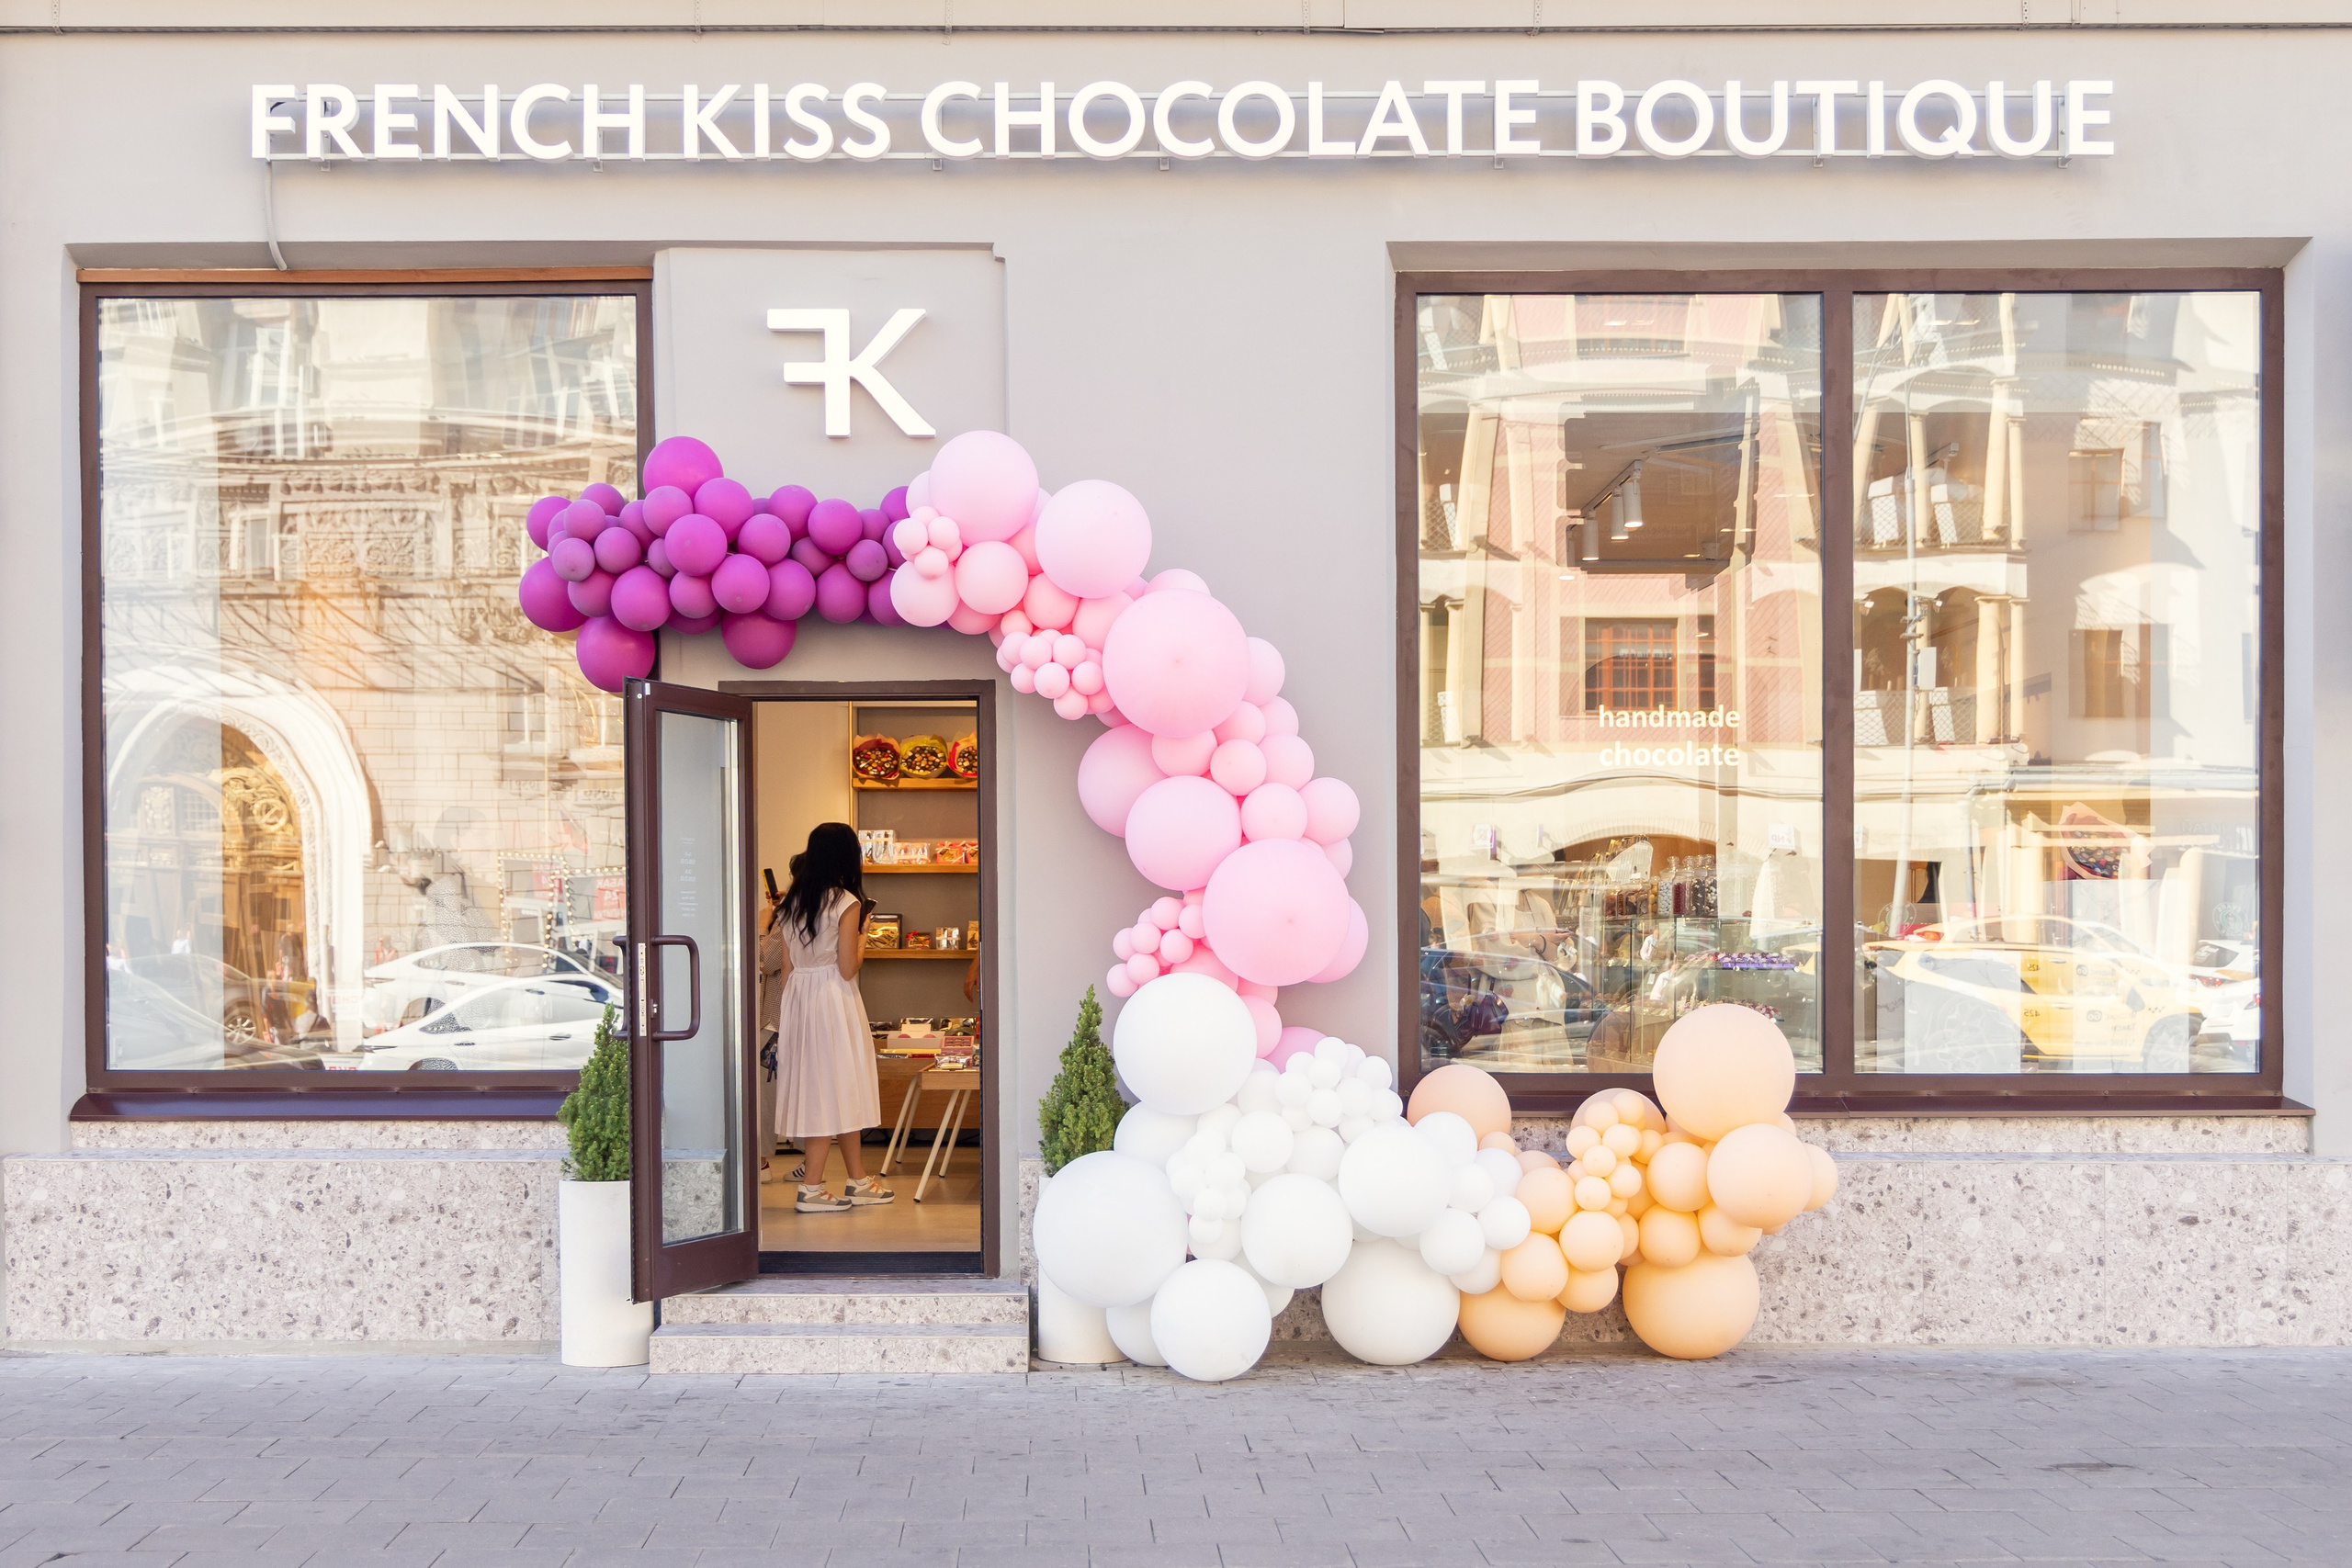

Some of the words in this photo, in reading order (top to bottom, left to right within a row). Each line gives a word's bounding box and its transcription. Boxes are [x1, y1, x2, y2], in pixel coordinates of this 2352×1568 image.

[251, 83, 645, 163] FRENCH
[683, 82, 892, 163] KISS
[921, 80, 1541, 161] CHOCOLATE
[1576, 79, 2115, 160] BOUTIQUE
[1599, 704, 1741, 728] handmade
[1599, 740, 1741, 767] chocolate
